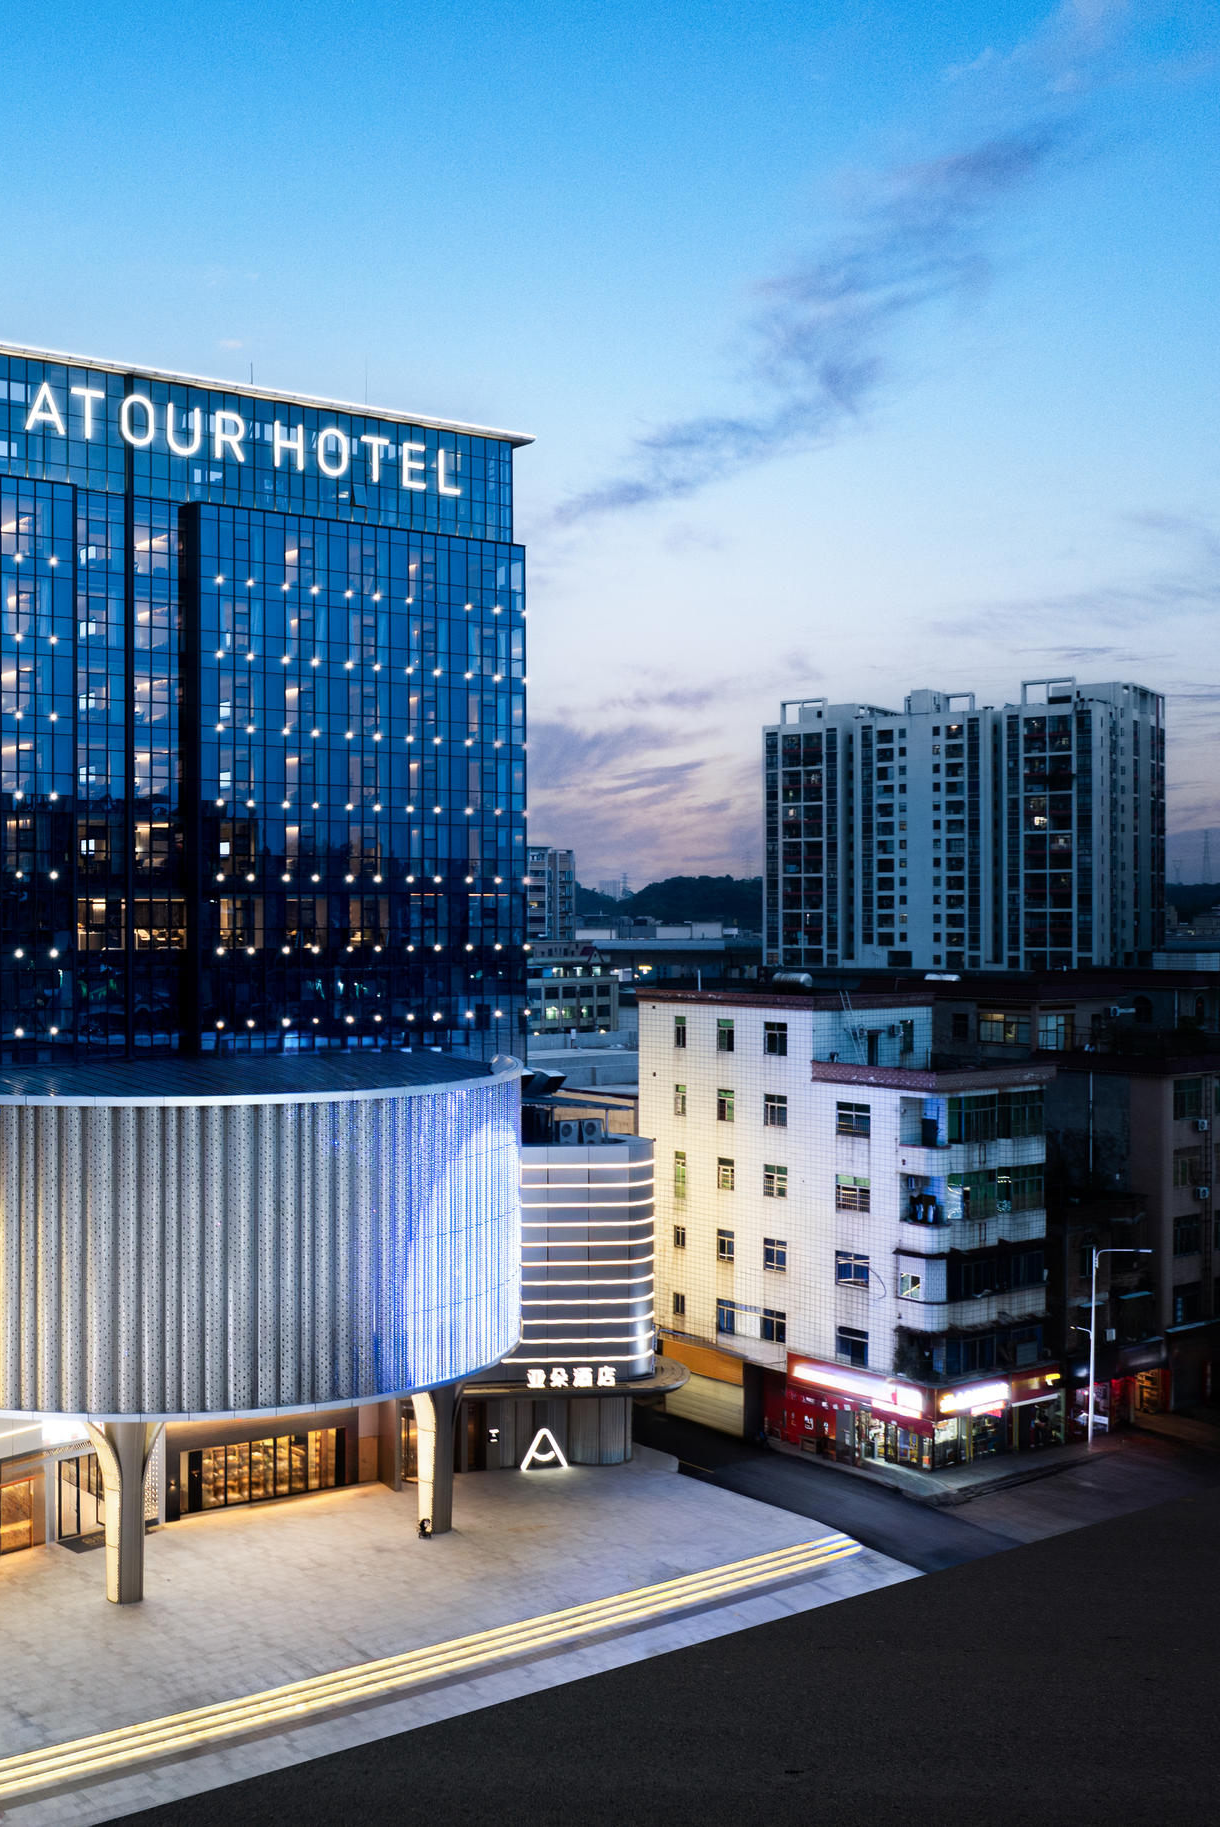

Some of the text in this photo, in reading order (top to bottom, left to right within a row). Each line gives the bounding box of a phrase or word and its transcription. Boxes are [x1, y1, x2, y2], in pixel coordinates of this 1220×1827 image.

[24, 380, 463, 496] ATOUR HOTEL
[526, 1365, 617, 1389] 亚朵酒店
